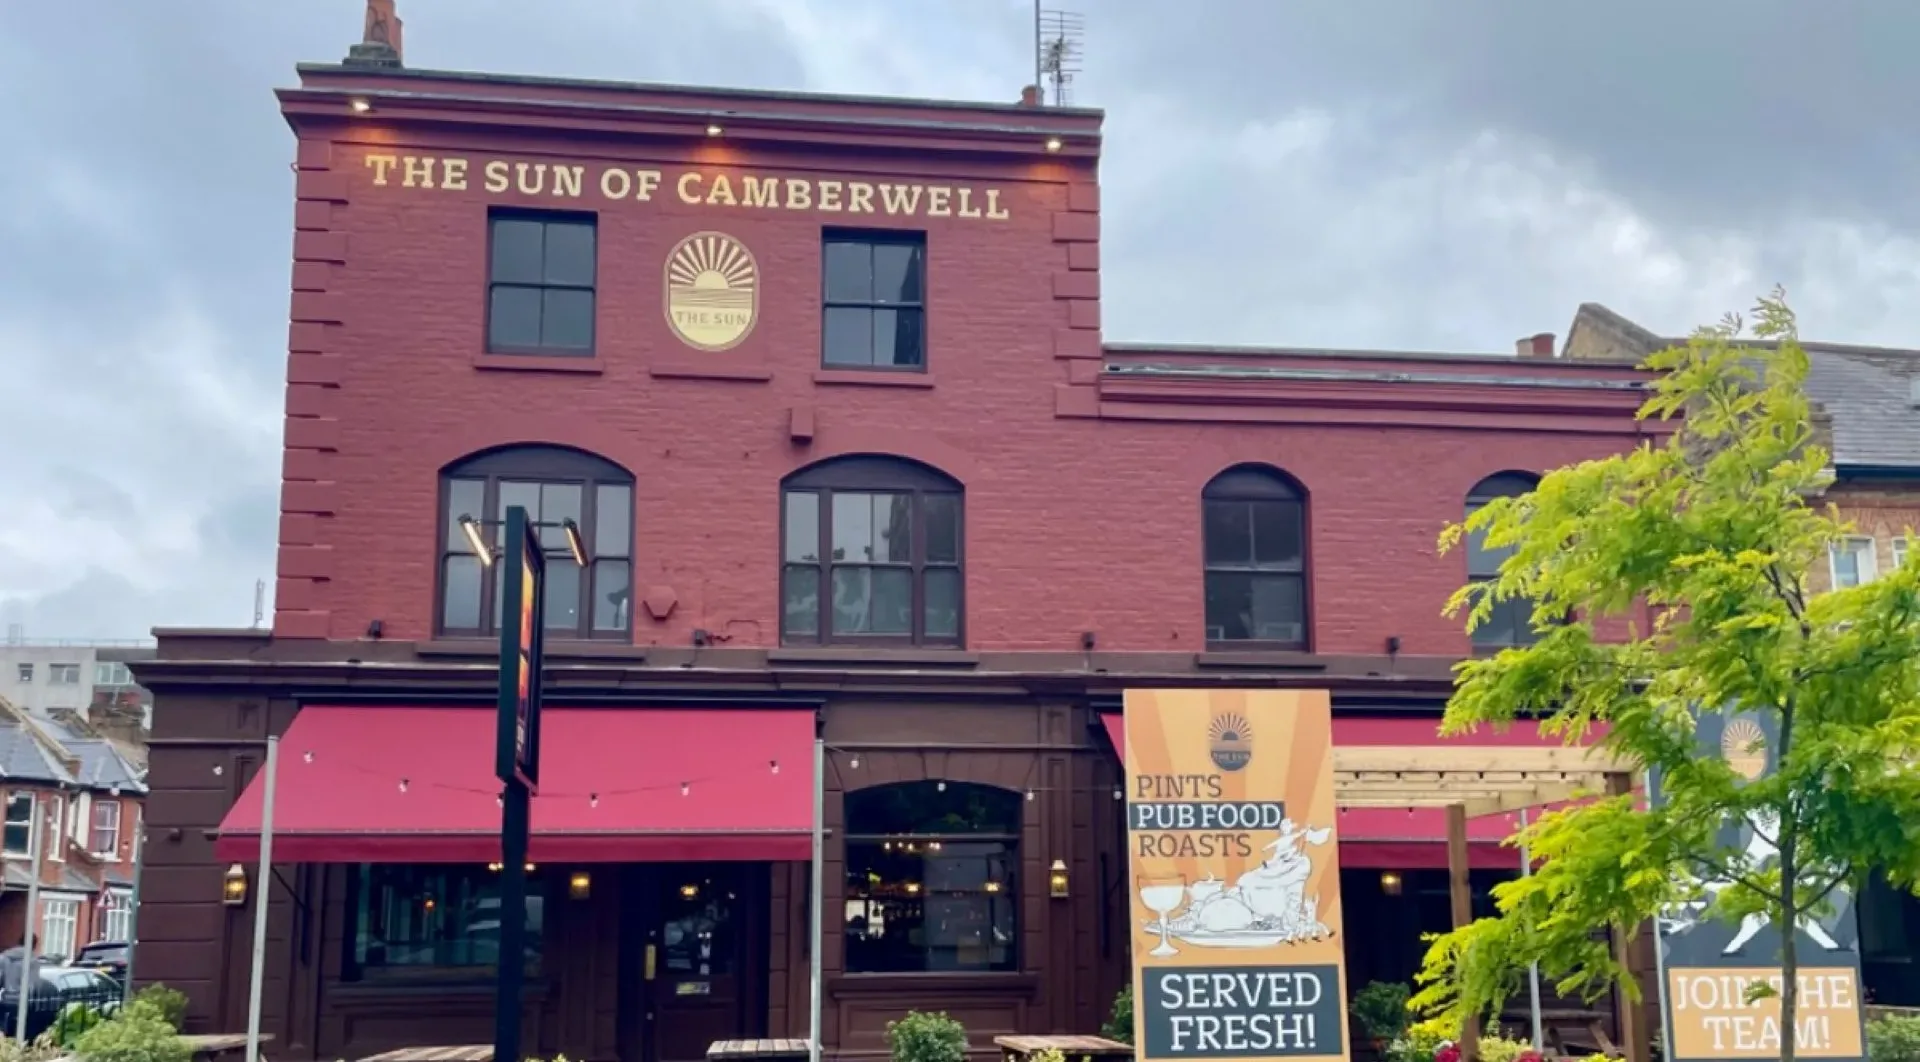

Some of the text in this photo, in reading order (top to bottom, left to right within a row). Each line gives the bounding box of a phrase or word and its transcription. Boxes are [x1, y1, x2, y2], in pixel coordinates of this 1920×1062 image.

[365, 154, 1009, 219] THE SUN OF CAMBERWELL
[675, 311, 747, 325] THE SUN
[1136, 774, 1222, 798] PINTS
[1136, 803, 1281, 828] PUB FOOD
[1139, 833, 1252, 858] ROASTS
[1160, 972, 1322, 1009] SERVED
[1170, 1013, 1317, 1051] FRESH!
[1703, 1015, 1831, 1050] TEAM!
